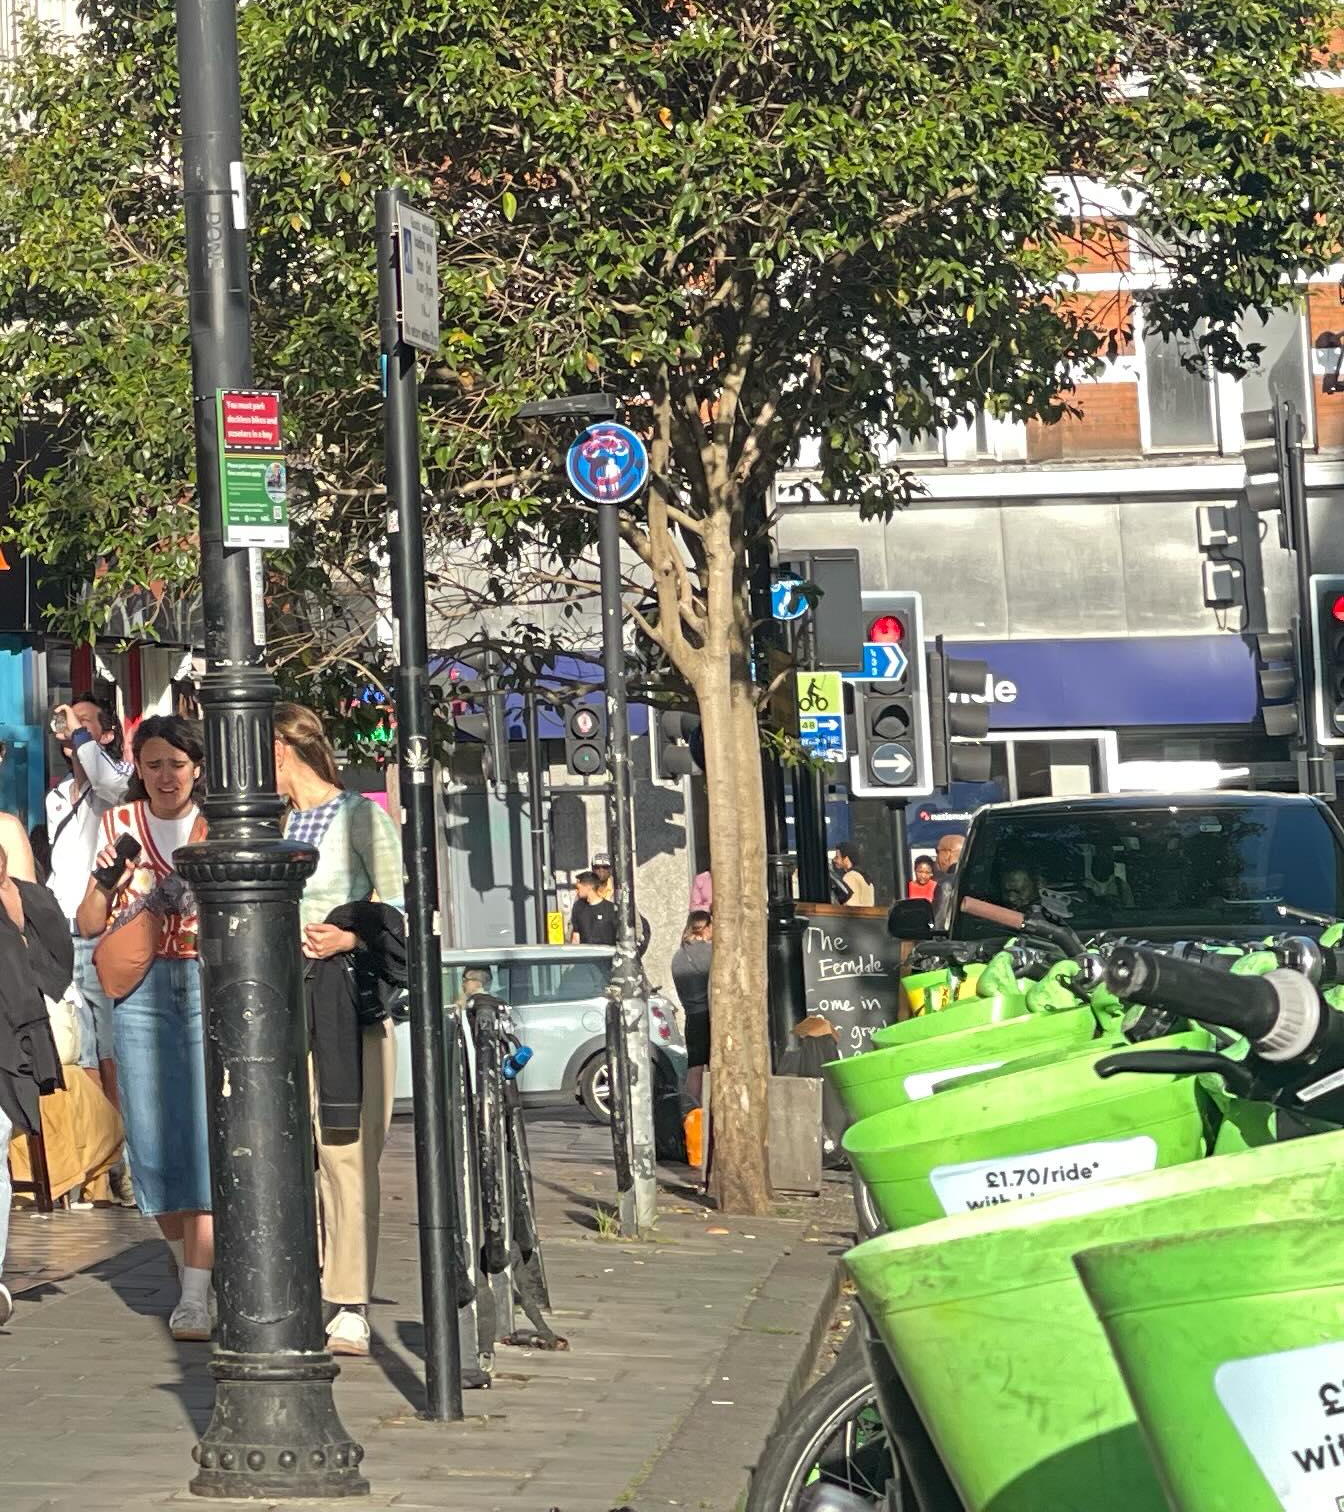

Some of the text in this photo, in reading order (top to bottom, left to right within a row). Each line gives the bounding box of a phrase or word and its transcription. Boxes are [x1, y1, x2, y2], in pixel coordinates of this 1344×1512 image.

[807, 926, 848, 954] The
[819, 954, 884, 978] Ferndale
[861, 996, 881, 1011] in
